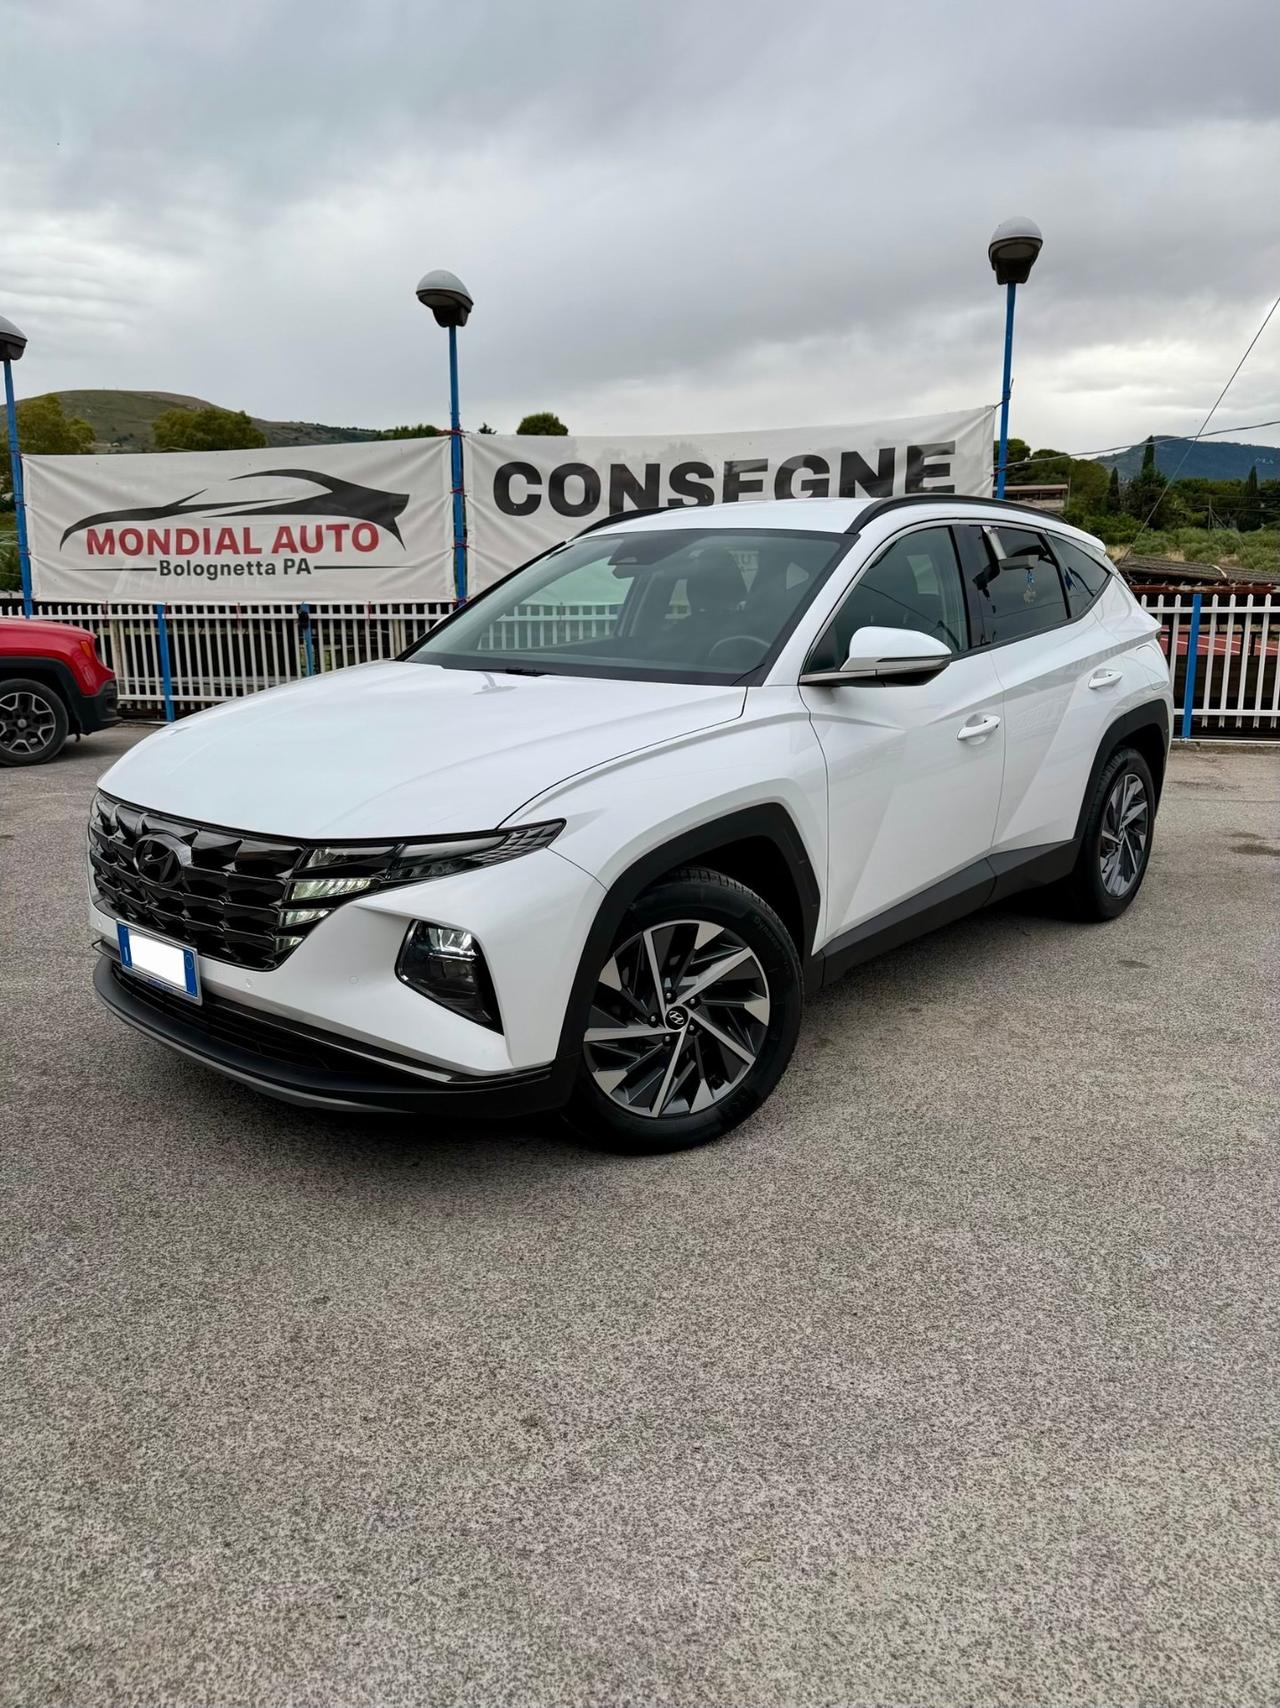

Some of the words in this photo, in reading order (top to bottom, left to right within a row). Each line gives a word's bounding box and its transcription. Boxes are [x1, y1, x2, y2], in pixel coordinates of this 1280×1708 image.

[493, 441, 956, 517] CONSEGNE
[86, 526, 262, 556] MONDIAL
[271, 522, 380, 554] AUTO
[158, 559, 277, 582] Bolognetta
[282, 557, 312, 576] PA
